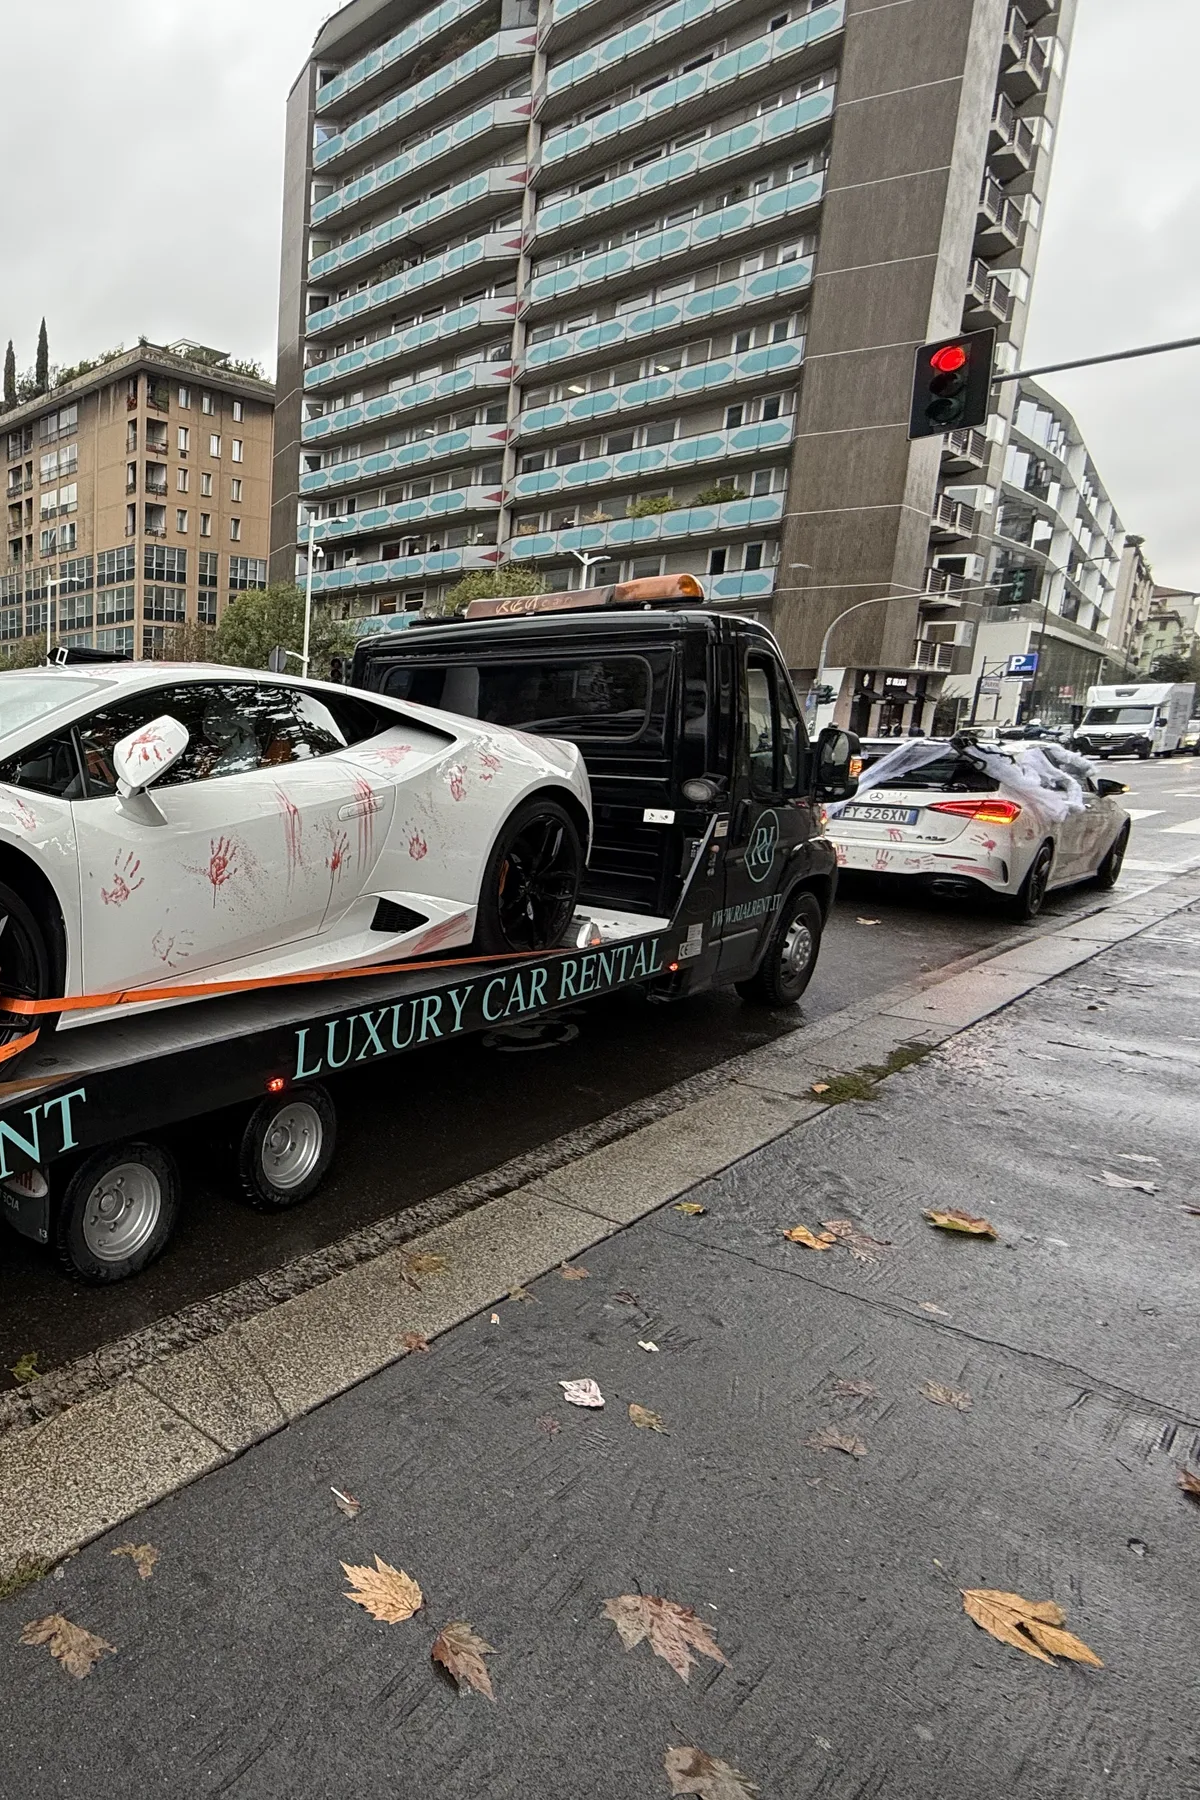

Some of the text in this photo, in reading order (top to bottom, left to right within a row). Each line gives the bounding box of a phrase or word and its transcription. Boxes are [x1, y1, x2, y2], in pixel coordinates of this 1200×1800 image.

[1009, 656, 1024, 671] P
[863, 808, 908, 822] 526XN
[292, 938, 664, 1081] LUXURY CAR RENTAL
